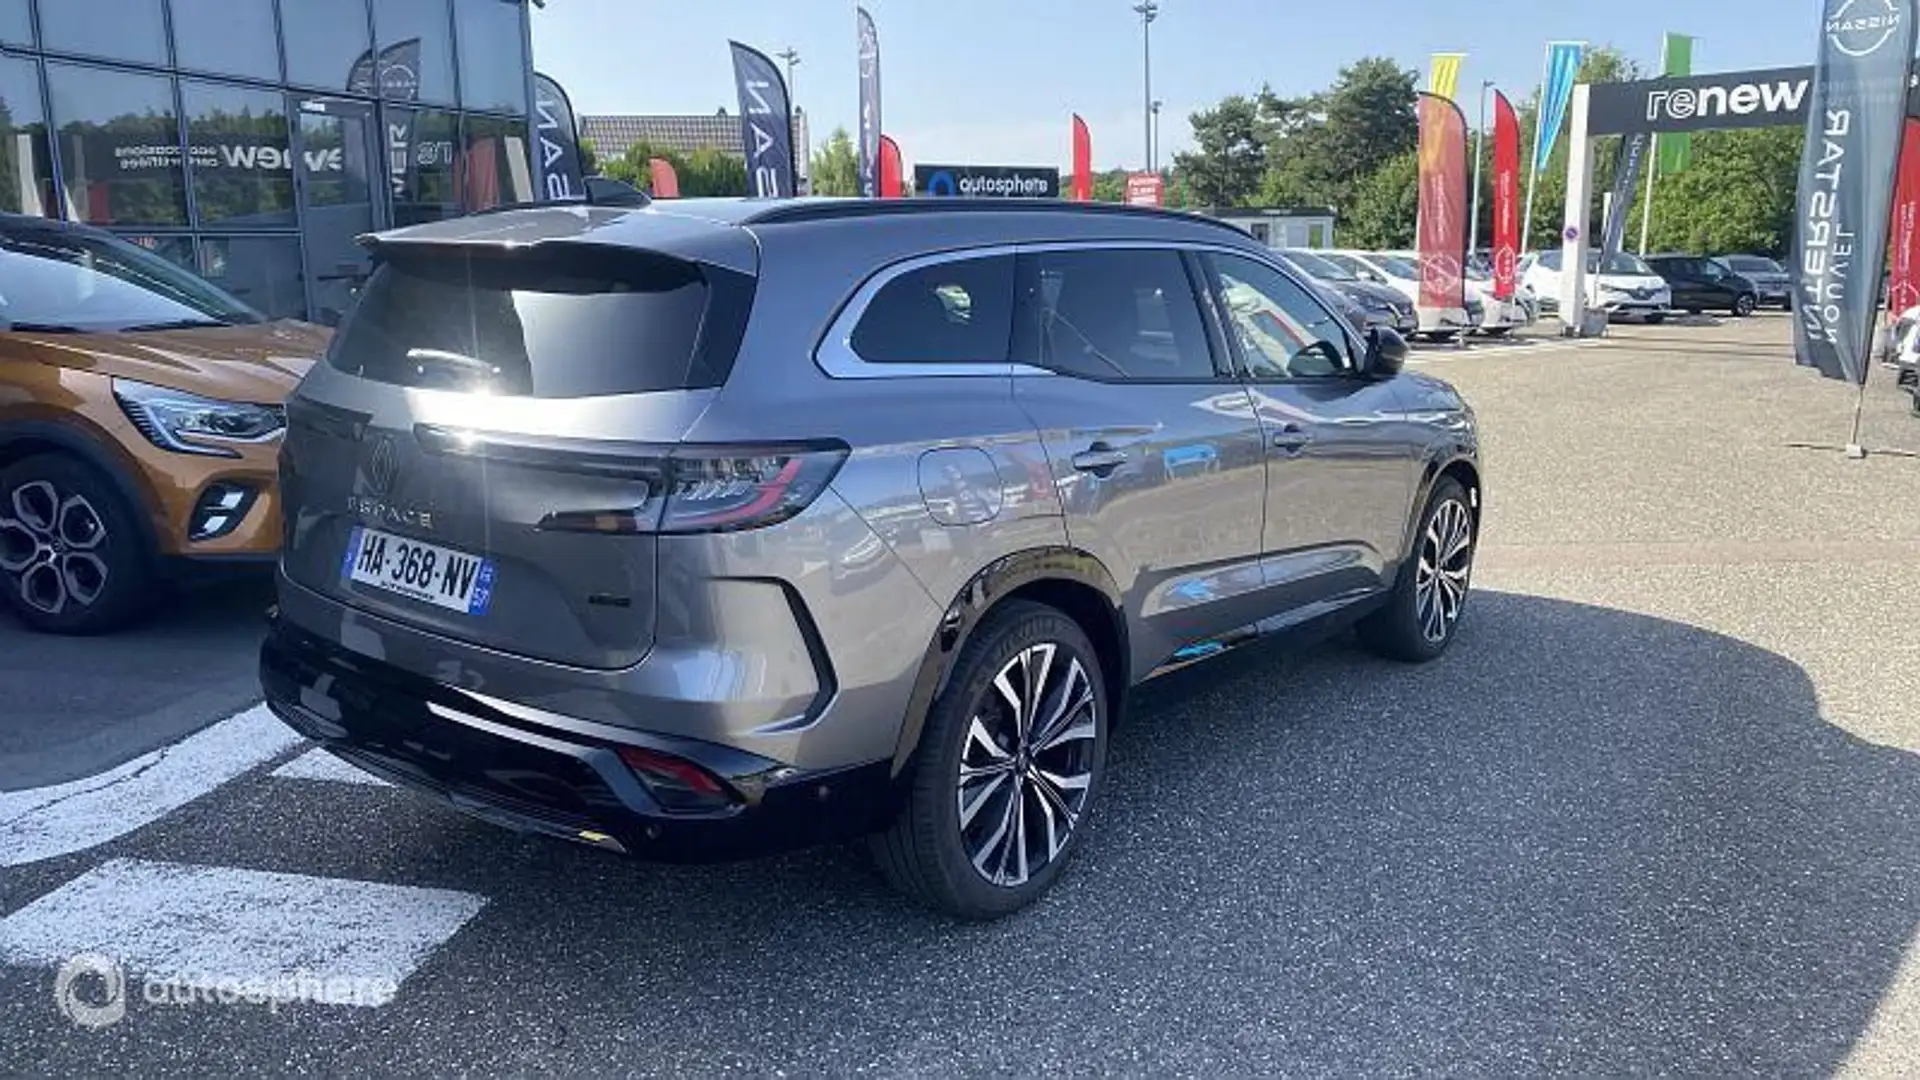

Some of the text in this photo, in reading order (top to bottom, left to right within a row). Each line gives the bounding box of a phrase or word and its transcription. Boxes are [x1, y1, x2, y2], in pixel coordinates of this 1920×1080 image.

[1646, 79, 1809, 121] renew
[959, 175, 1049, 198] autosphere
[357, 534, 479, 600] HA-368-NV
